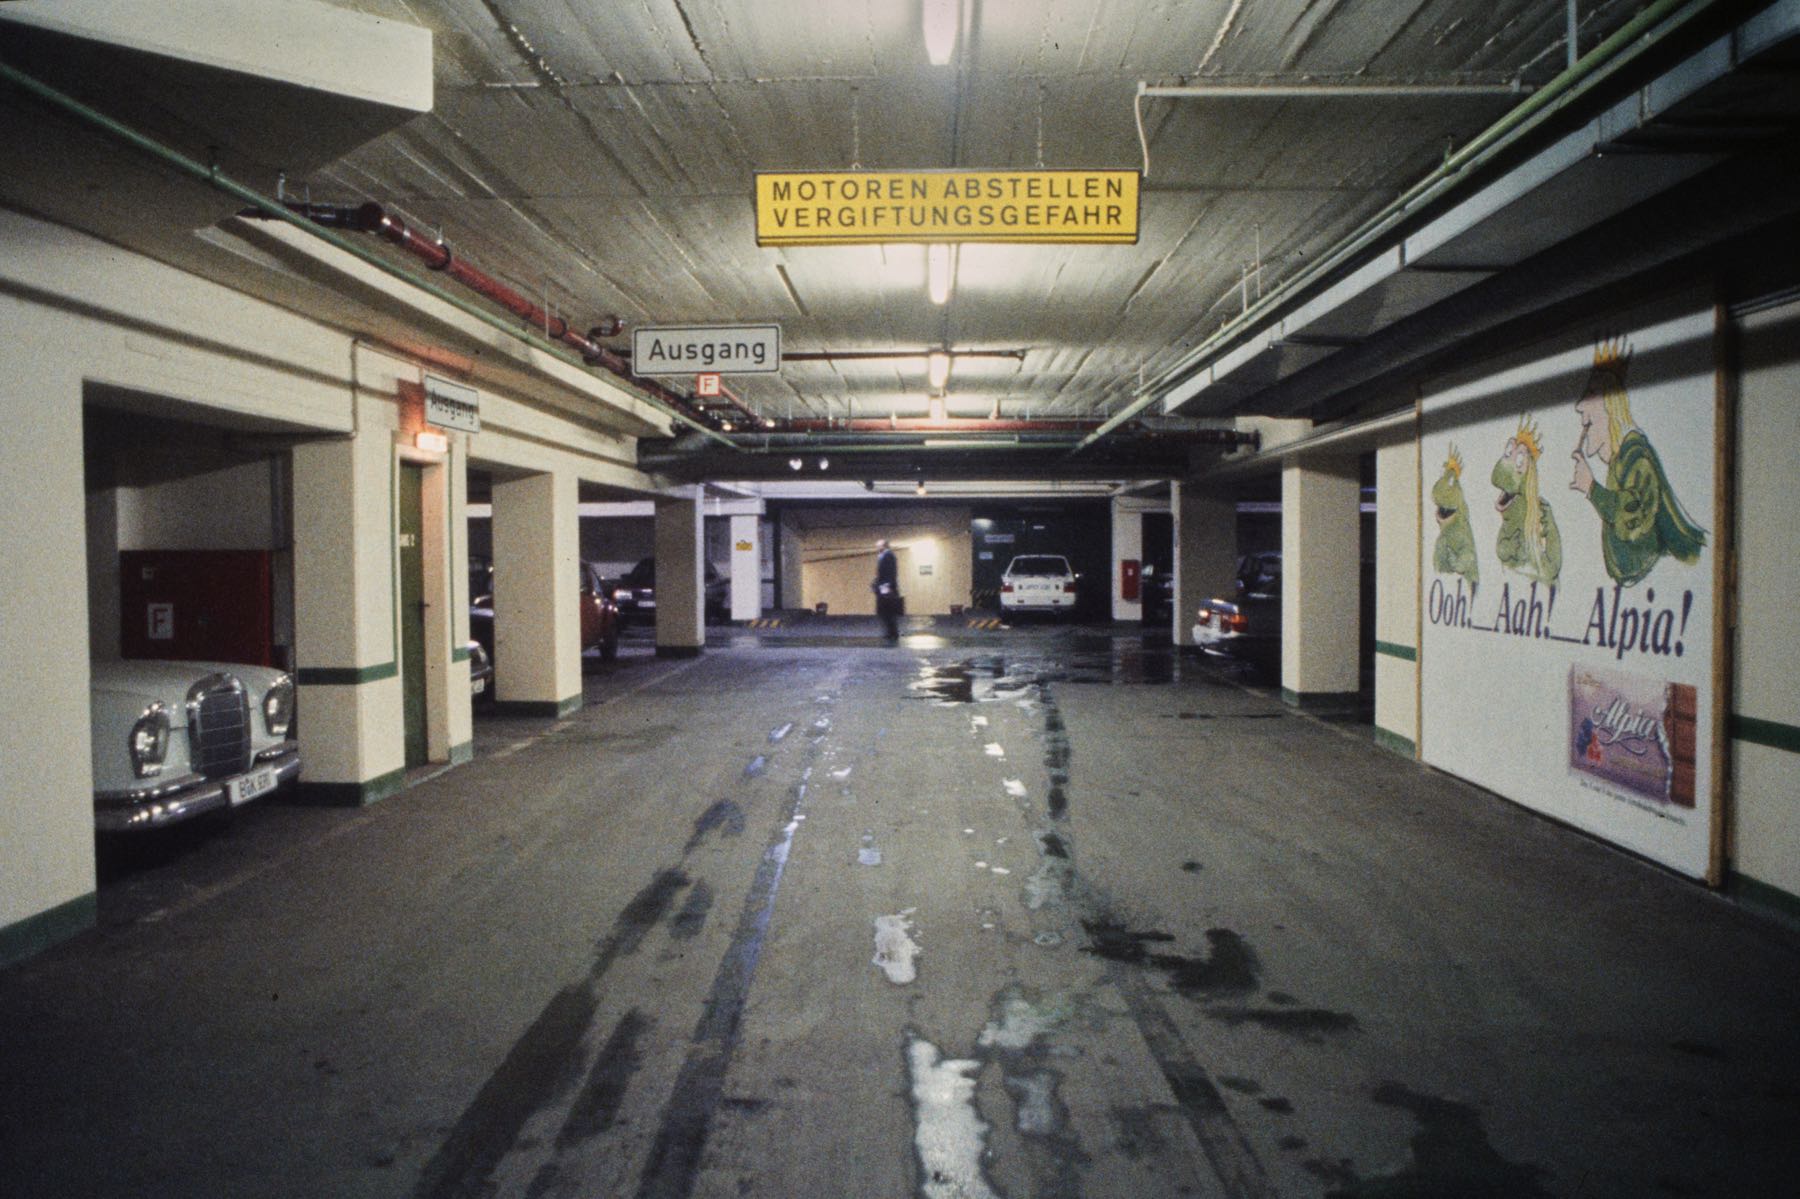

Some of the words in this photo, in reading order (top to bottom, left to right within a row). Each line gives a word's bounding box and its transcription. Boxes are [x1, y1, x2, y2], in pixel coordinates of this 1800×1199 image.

[773, 180, 927, 201] MOTOREN
[944, 178, 1122, 198] ABSTELLEN
[773, 205, 1122, 227] VERGIFTUNGSGEFAHR
[649, 339, 765, 365] Ausgang
[703, 378, 714, 392] F
[431, 388, 474, 425] Ausgang
[153, 607, 169, 635] F
[1582, 584, 1693, 660] Alpia!
[1591, 697, 1659, 755] Alpia
